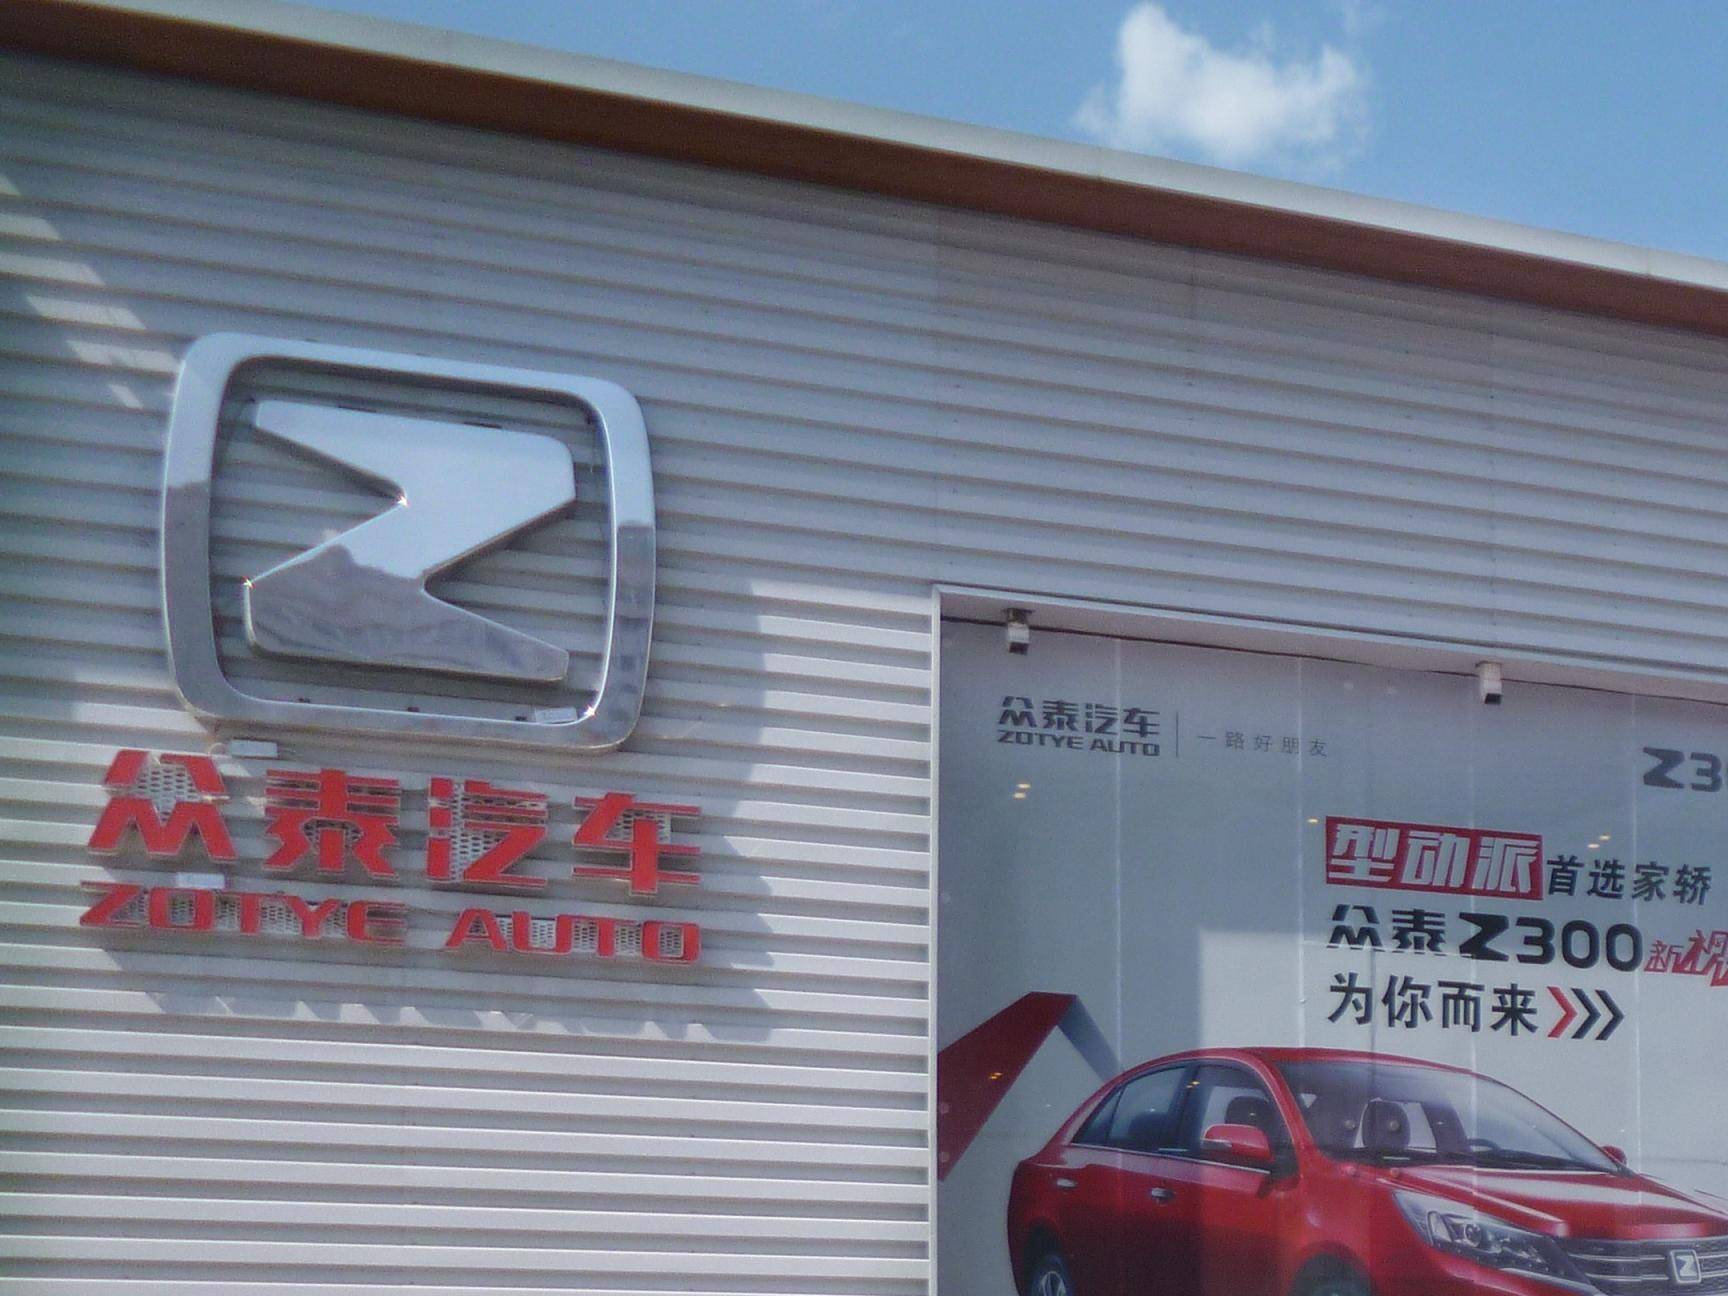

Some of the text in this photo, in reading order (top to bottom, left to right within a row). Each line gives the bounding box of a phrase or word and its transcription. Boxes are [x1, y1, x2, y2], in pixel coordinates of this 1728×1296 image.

[997, 730, 1160, 757] ZOTYE AUTO
[998, 696, 1160, 738] 众泰汽车
[1198, 731, 1327, 759] 一路好朋友
[86, 748, 702, 896] 众泰汽车
[1328, 822, 1712, 906] 型动派 首选家轿
[79, 881, 702, 964] ZOTYE AUTO
[1327, 904, 1643, 972] 众泰Z300
[1327, 971, 1539, 1036] 为你而来
